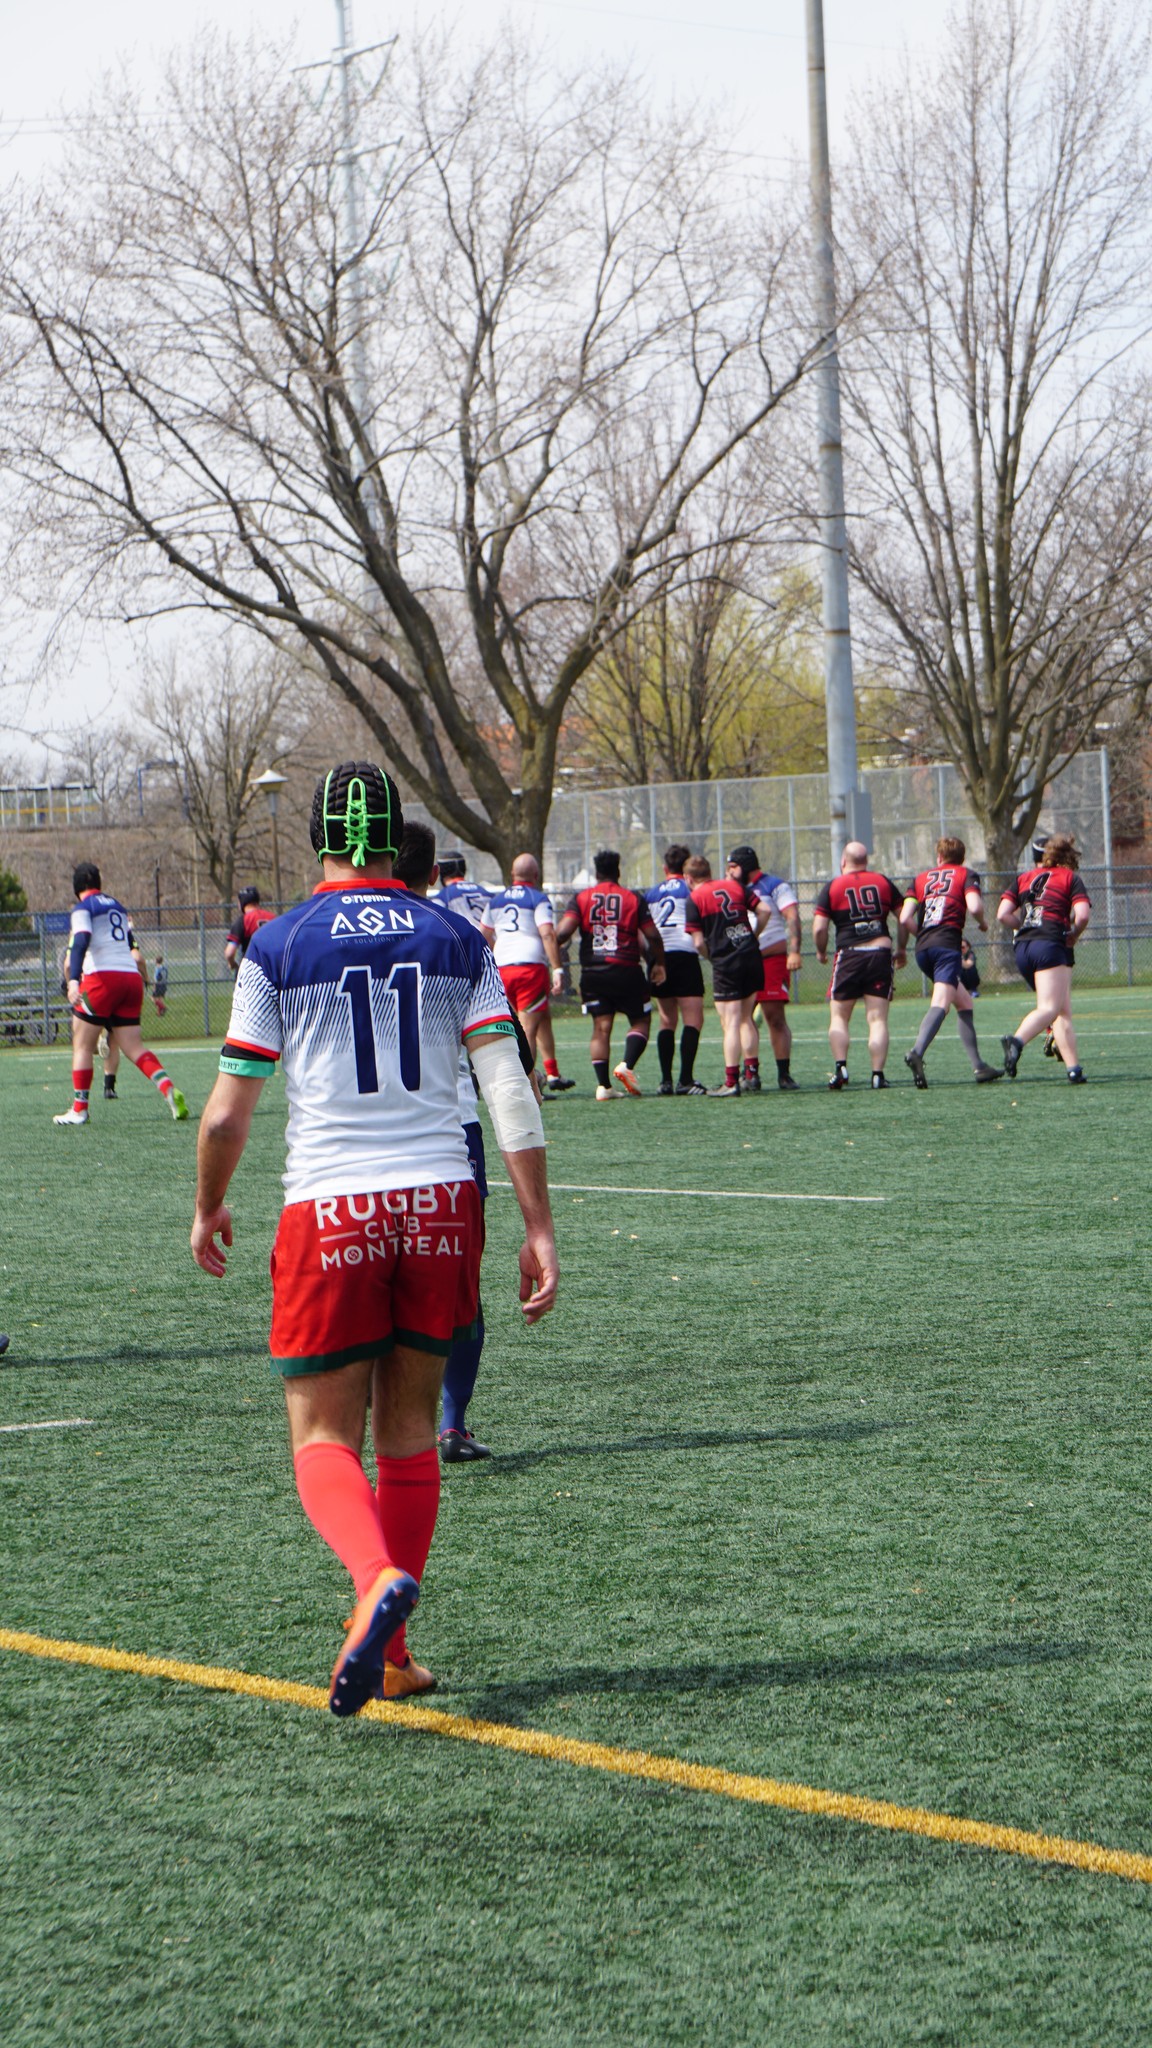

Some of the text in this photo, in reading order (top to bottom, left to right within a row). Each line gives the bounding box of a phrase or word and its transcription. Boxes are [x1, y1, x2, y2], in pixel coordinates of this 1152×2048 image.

[924, 870, 954, 897] 25
[1030, 871, 1053, 900] 4
[462, 893, 485, 923] 5
[503, 903, 520, 932] 3
[589, 893, 623, 924] 29
[656, 895, 678, 928] 2
[713, 889, 739, 920] 2
[845, 884, 882, 920] 19
[108, 909, 126, 942] 8
[331, 906, 415, 937] ASN
[340, 961, 422, 1095] 11
[314, 1182, 461, 1230] RUGBY
[364, 1216, 421, 1239] CLUB
[320, 1235, 463, 1272] MONTREAL
